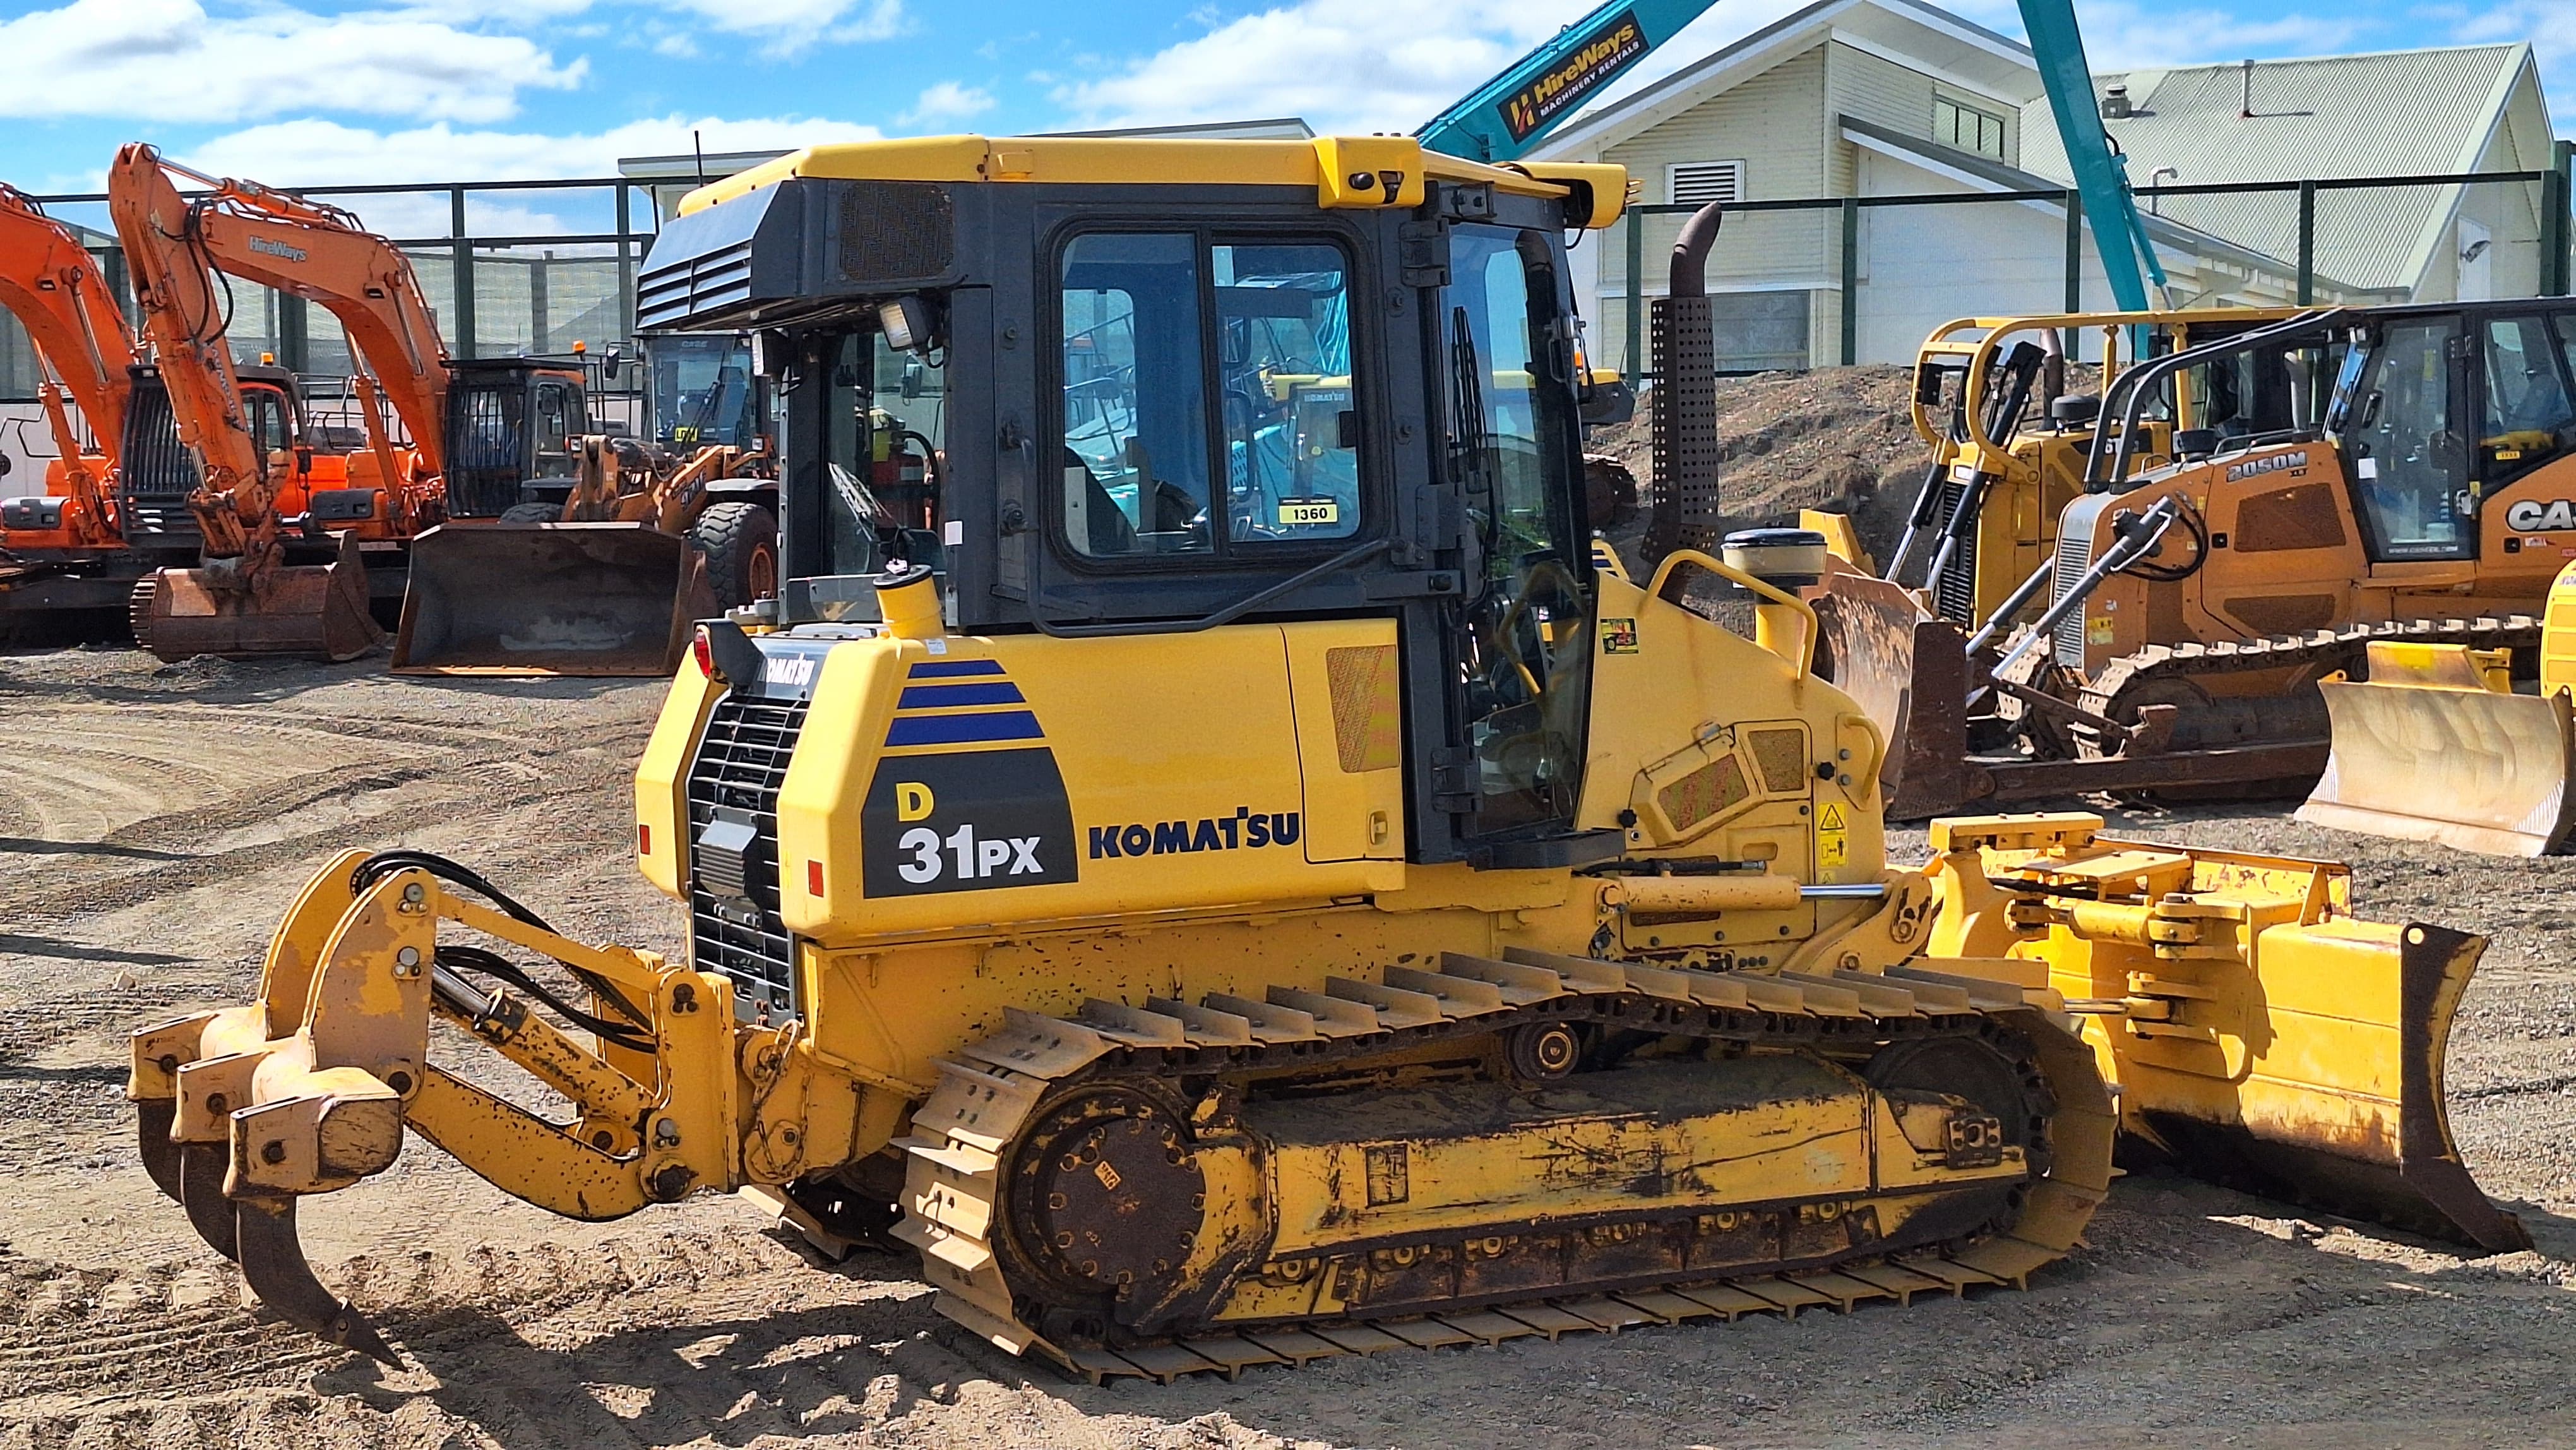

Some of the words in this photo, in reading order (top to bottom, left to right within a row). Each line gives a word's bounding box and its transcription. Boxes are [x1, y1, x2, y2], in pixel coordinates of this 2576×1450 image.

[1534, 23, 1635, 104] HireWays
[1539, 71, 1597, 117] MACHINERY
[1598, 40, 1640, 75] RENTALS
[249, 236, 306, 262] HireWays
[2227, 451, 2307, 482] 2050M
[1294, 508, 1328, 520] 1360
[896, 782, 934, 822] D
[898, 824, 1044, 884] 31PX
[1089, 806, 1299, 860] KOMATSU
